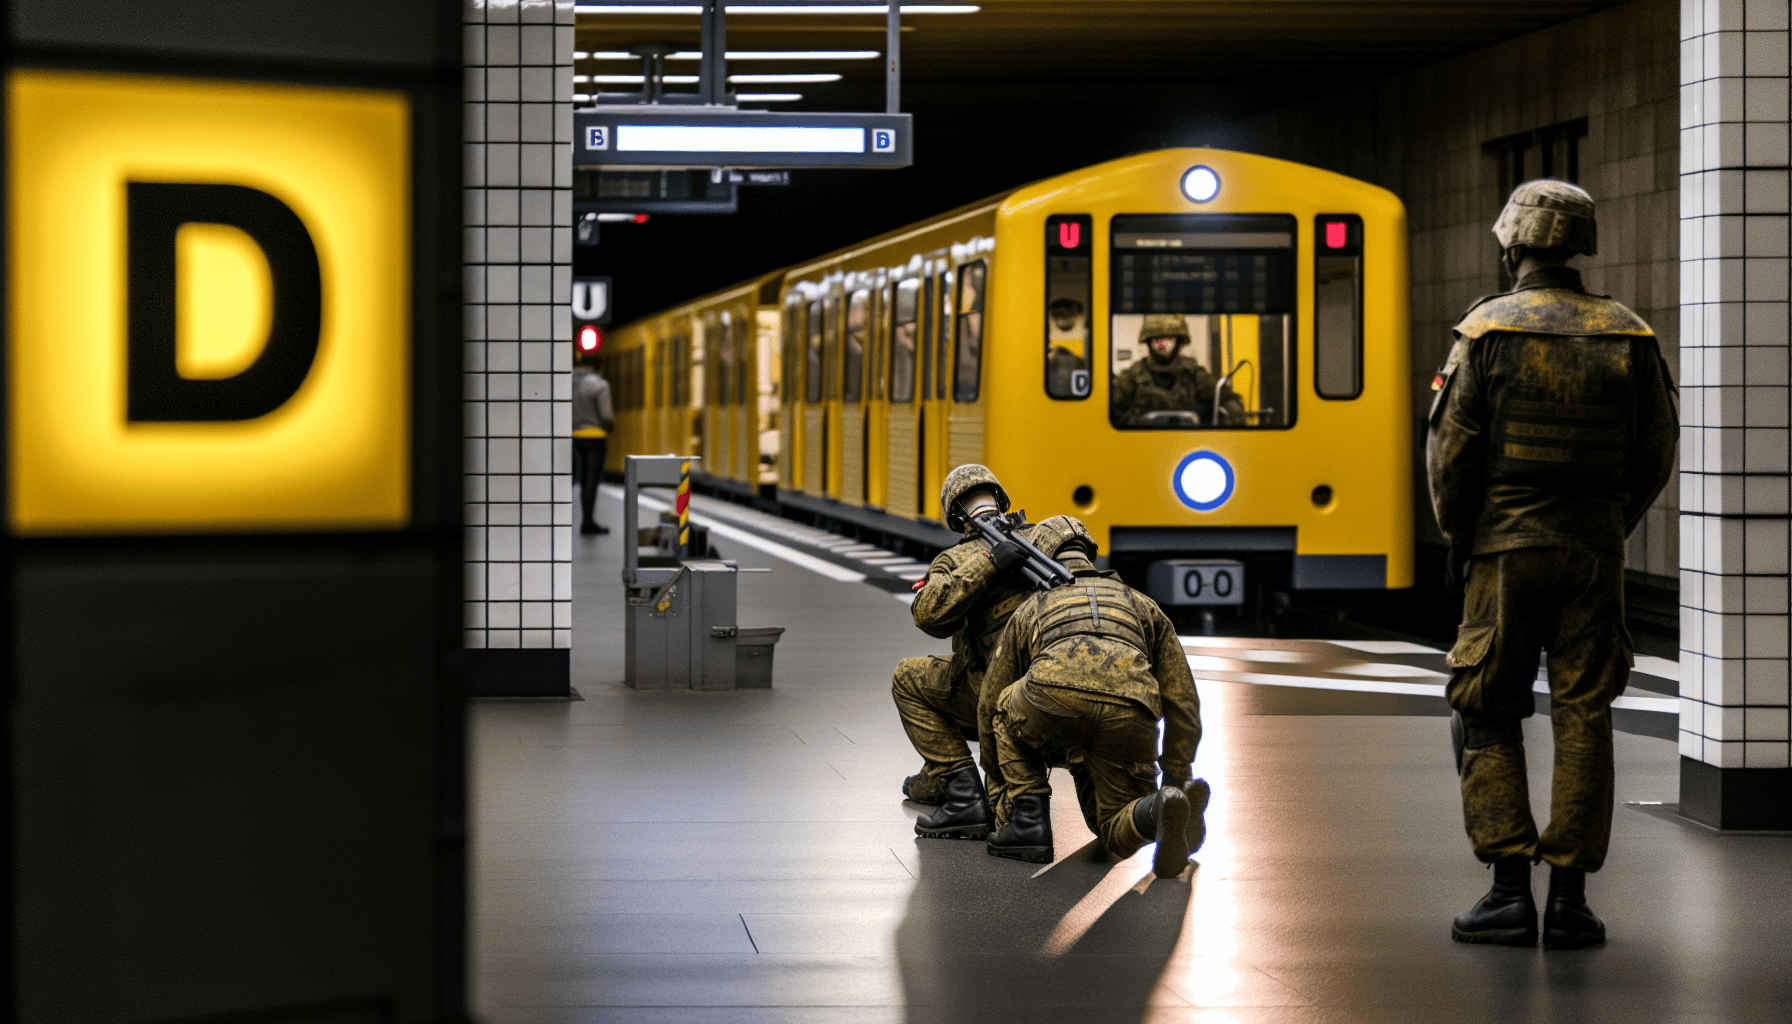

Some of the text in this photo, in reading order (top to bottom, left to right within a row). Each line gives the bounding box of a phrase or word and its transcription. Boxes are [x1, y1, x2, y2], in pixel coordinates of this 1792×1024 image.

[1059, 222, 1080, 249] U
[126, 181, 322, 422] D
[572, 281, 607, 320] U
